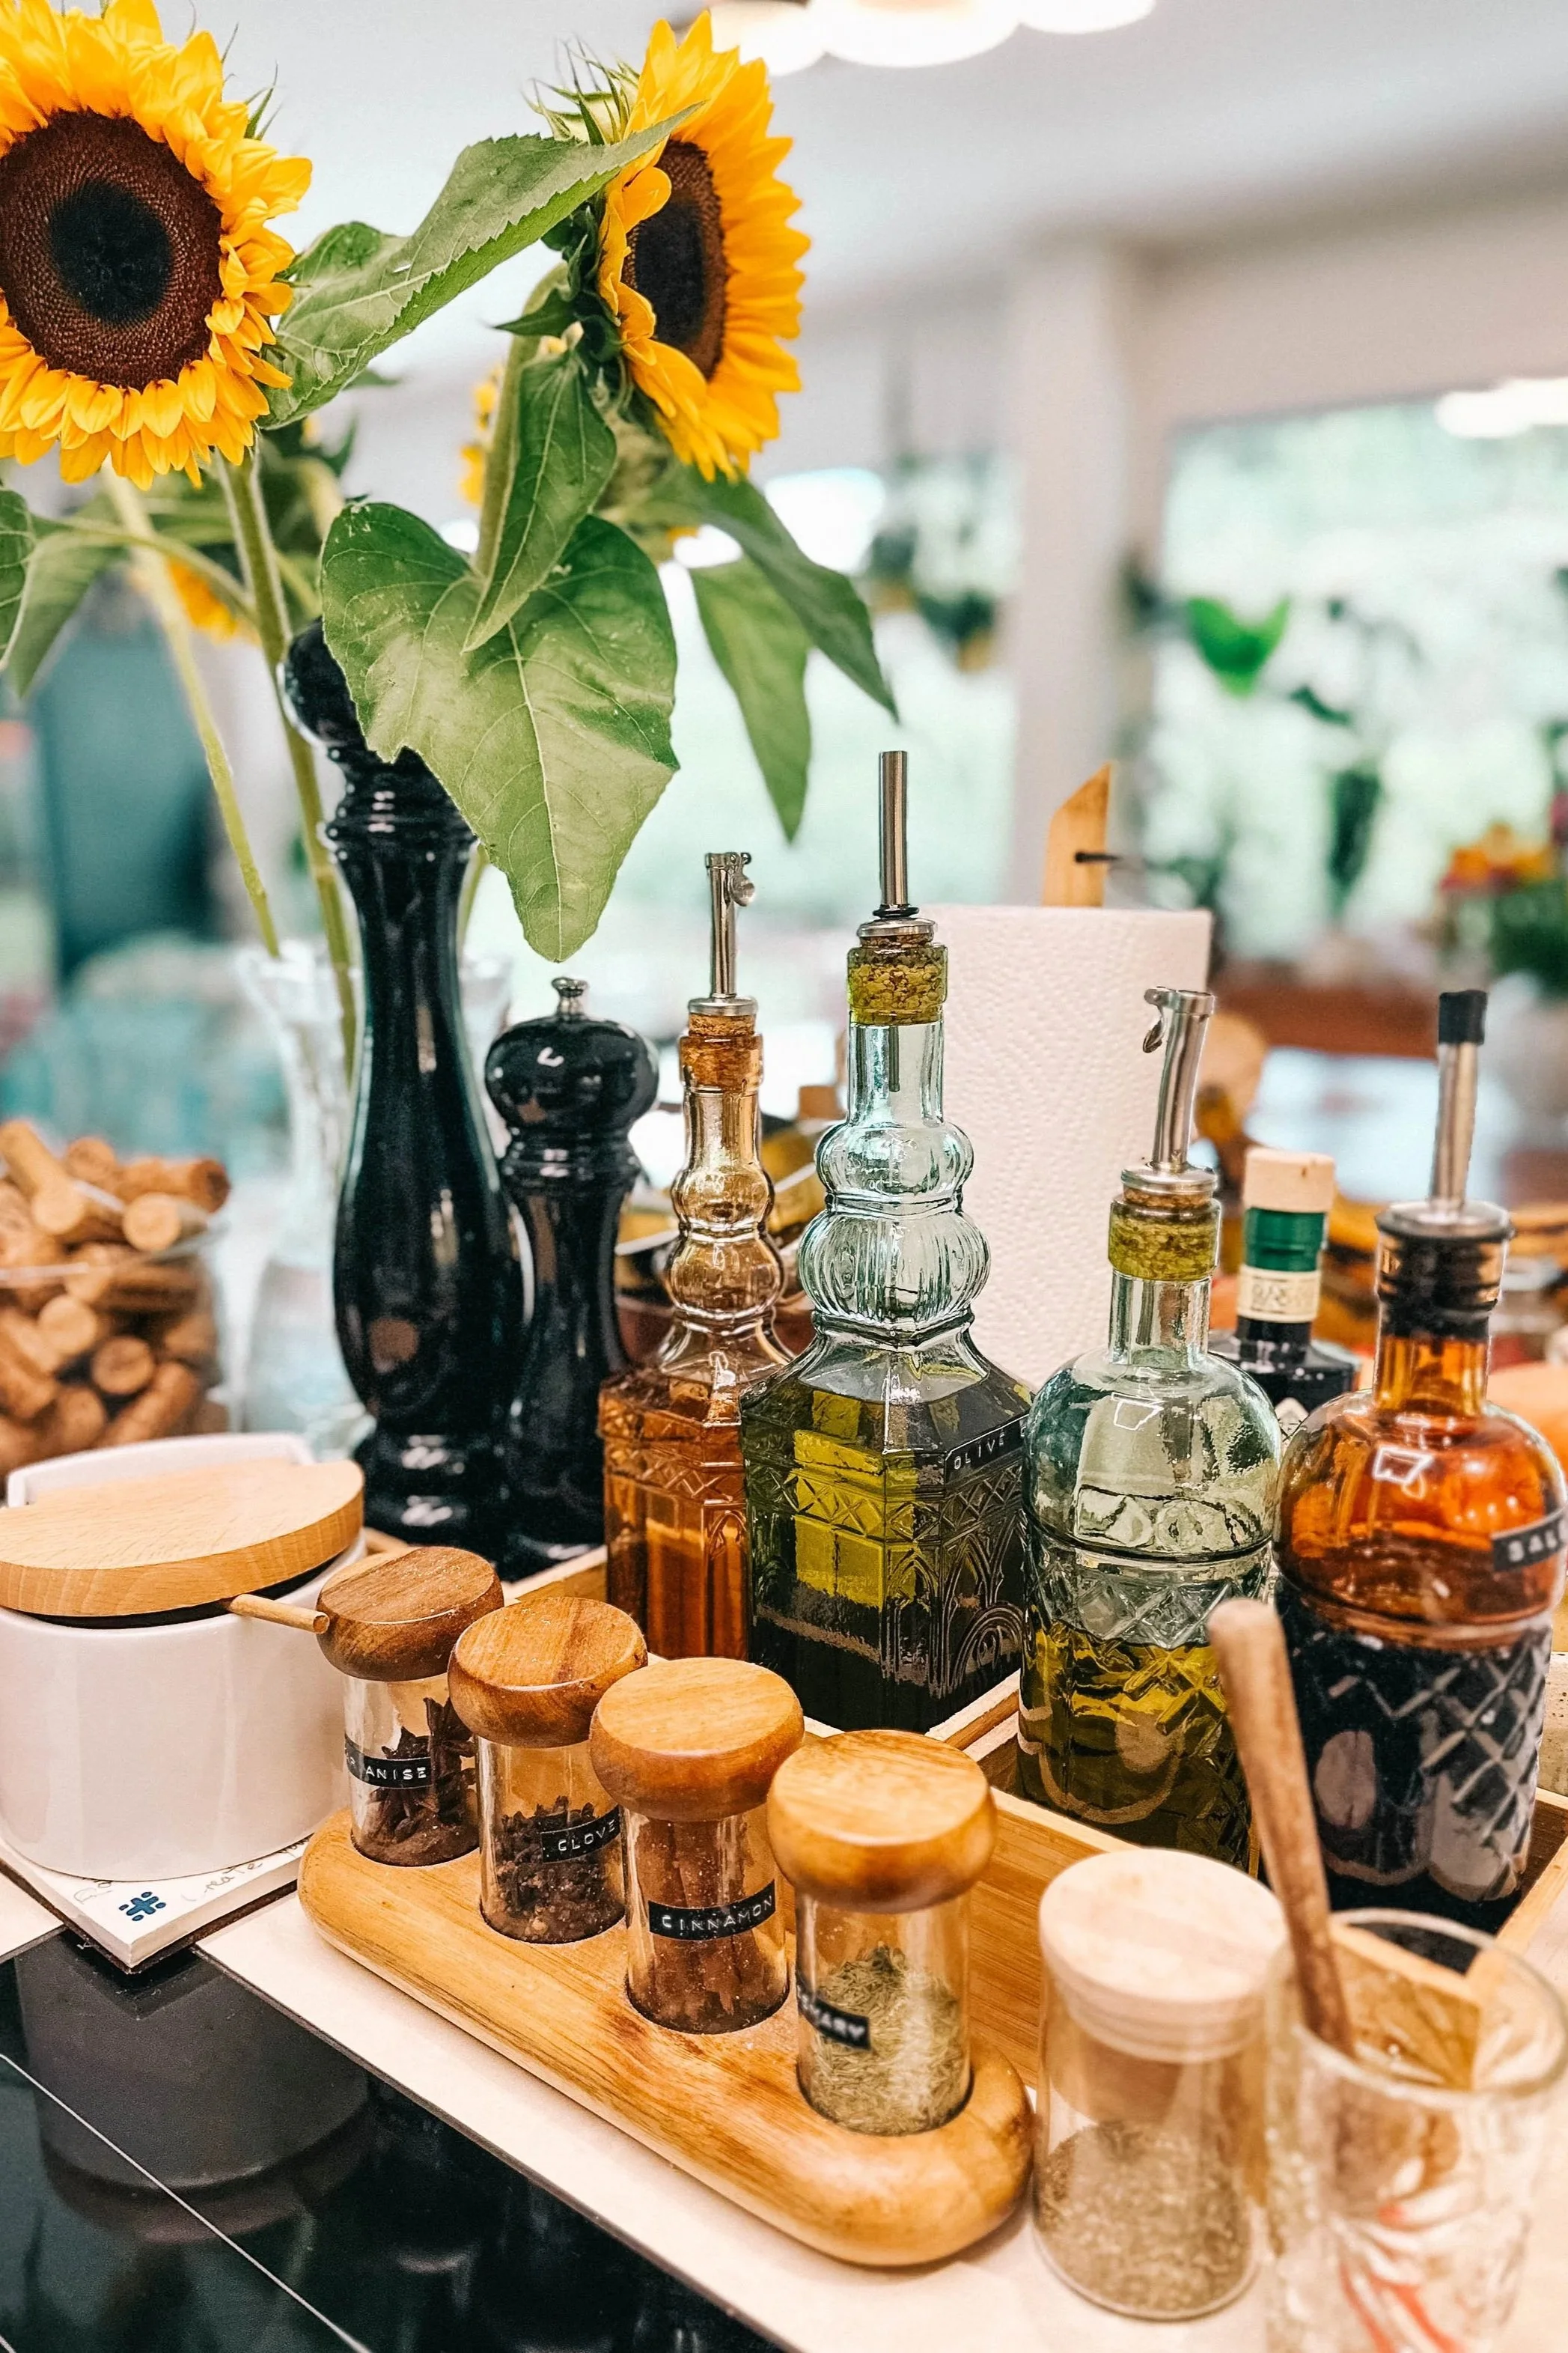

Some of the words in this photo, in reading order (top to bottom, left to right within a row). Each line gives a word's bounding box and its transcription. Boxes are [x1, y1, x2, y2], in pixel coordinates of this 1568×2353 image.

[954, 1429, 1005, 1470] OLIVE
[365, 1765, 427, 1780] ANISE
[558, 1818, 615, 1851] CLOVE
[662, 1895, 772, 1932] CINNAMON
